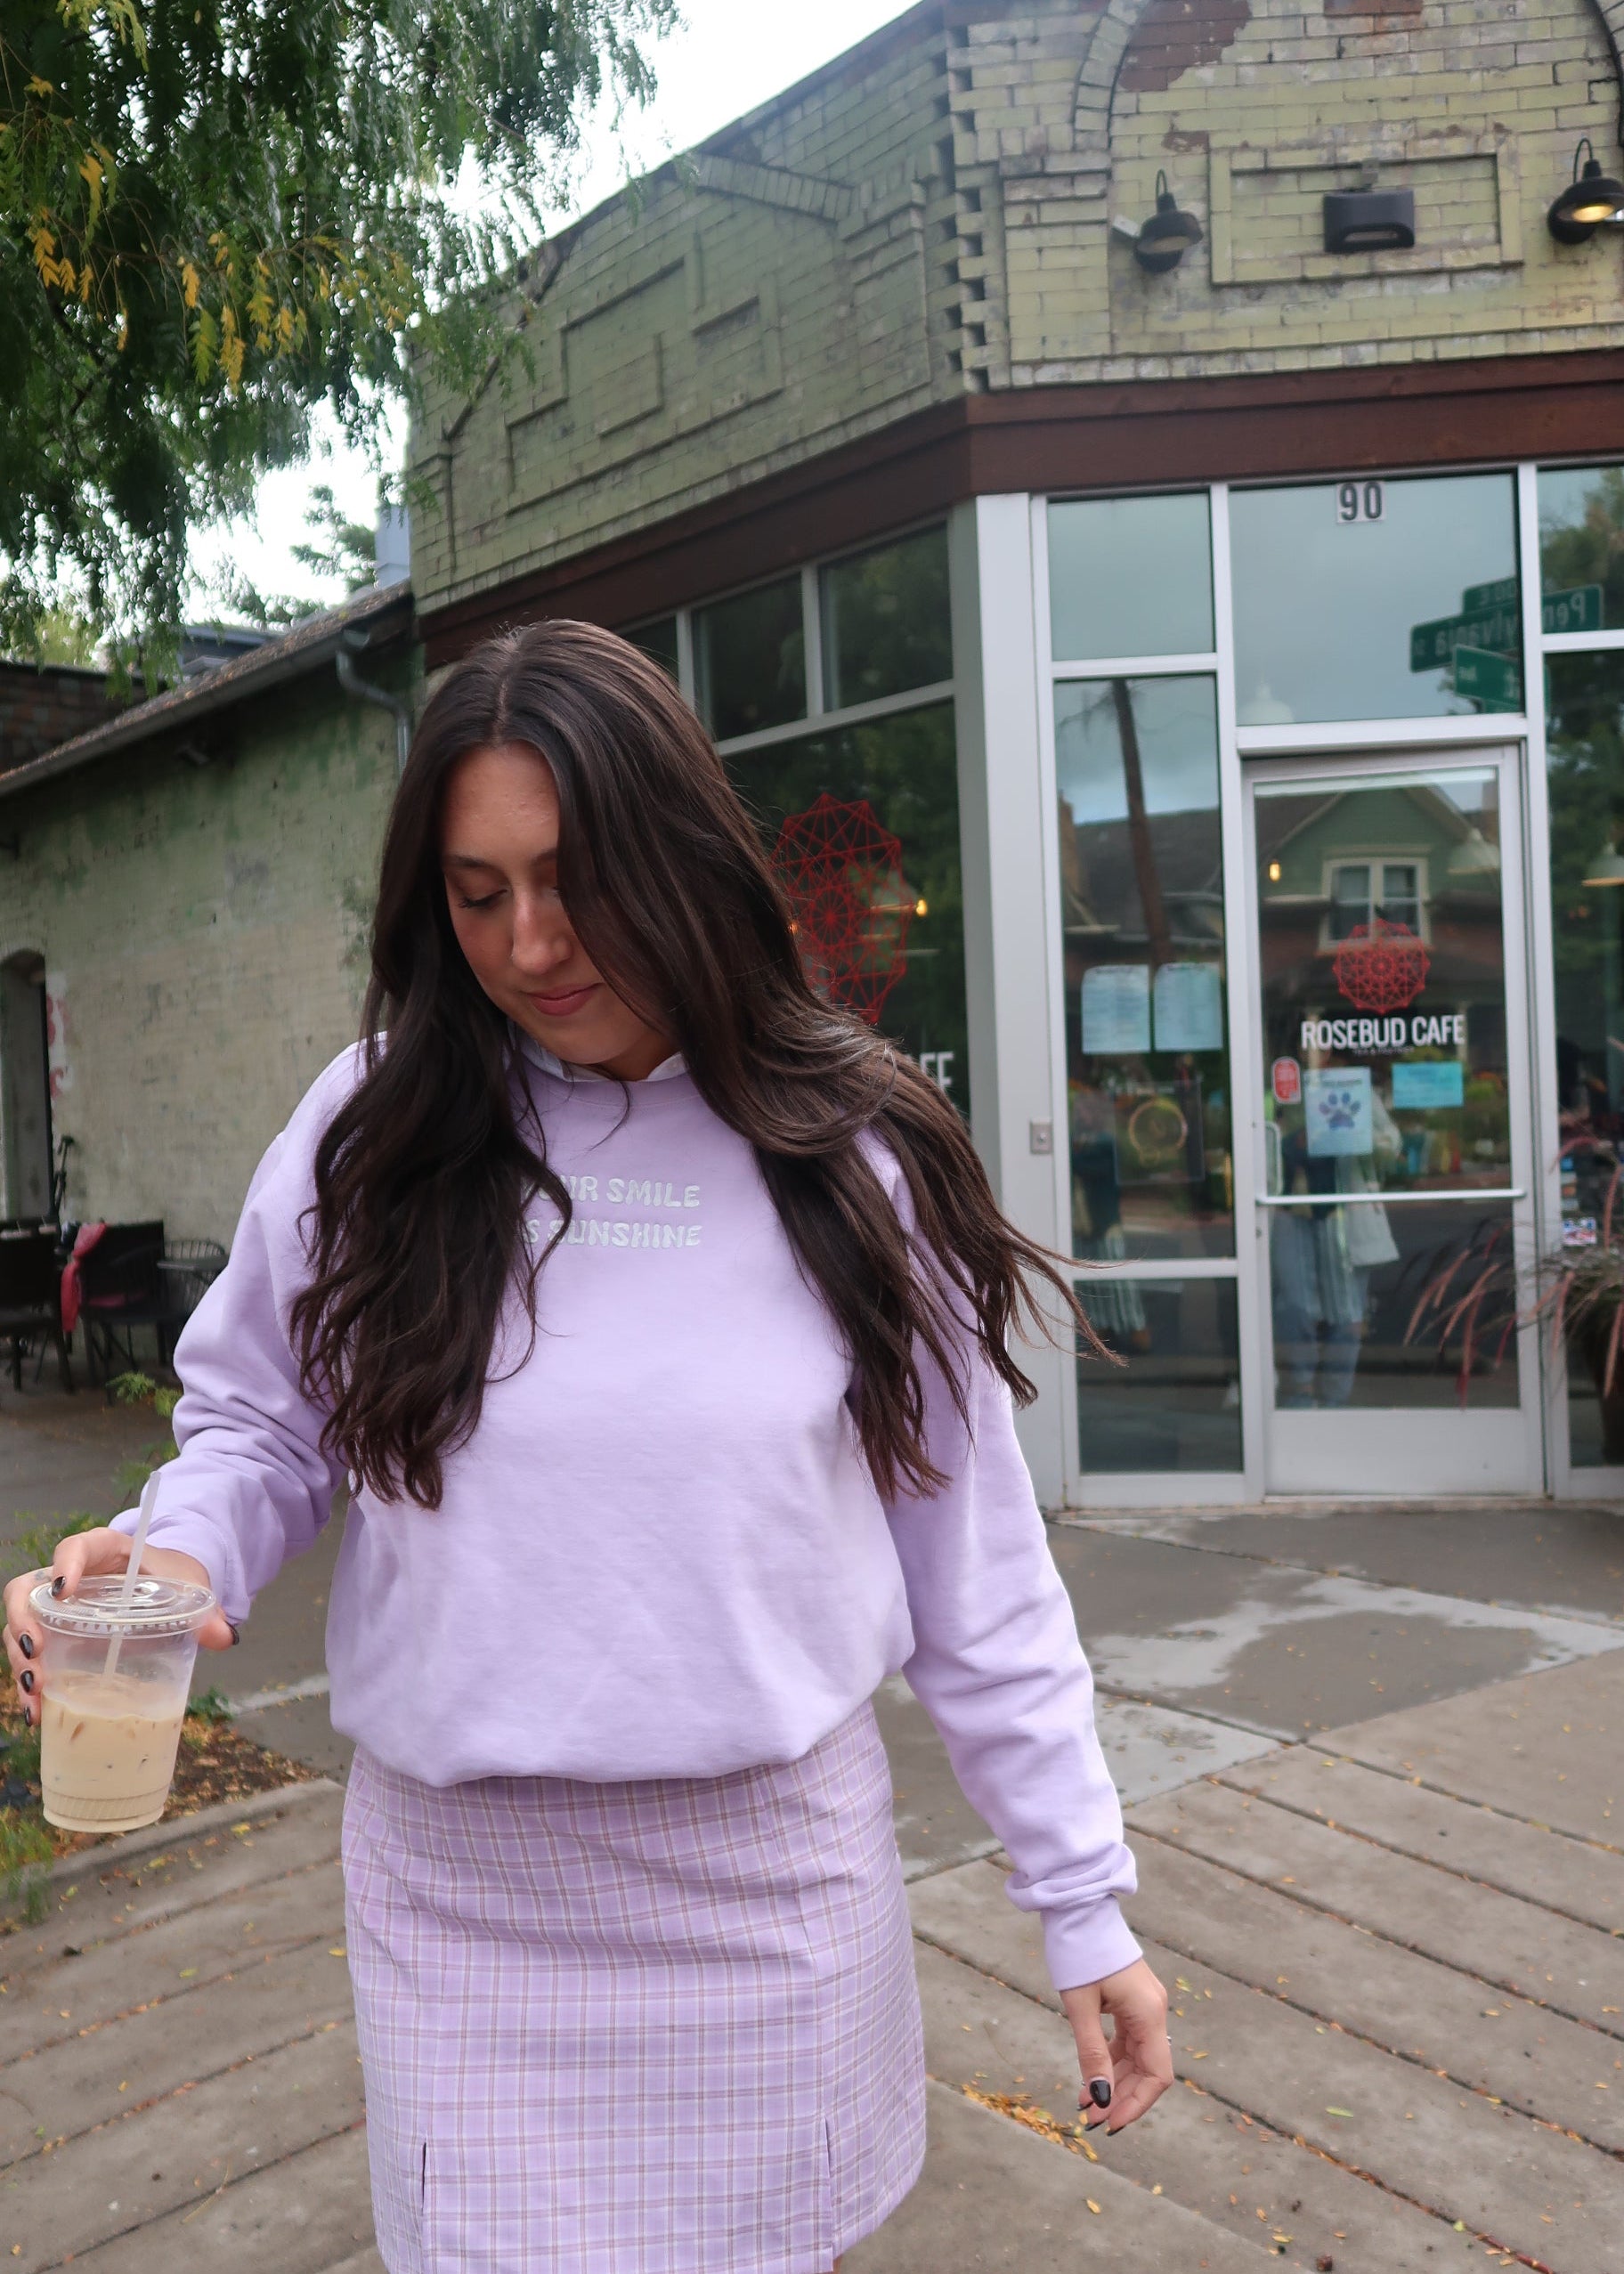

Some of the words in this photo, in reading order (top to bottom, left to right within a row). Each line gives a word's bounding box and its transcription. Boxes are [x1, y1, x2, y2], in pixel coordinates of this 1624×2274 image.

[1339, 482, 1383, 521] 90
[1301, 1017, 1406, 1051] ROSEBUD
[1411, 1014, 1466, 1046] CAFE
[606, 1178, 701, 1207] SMILE
